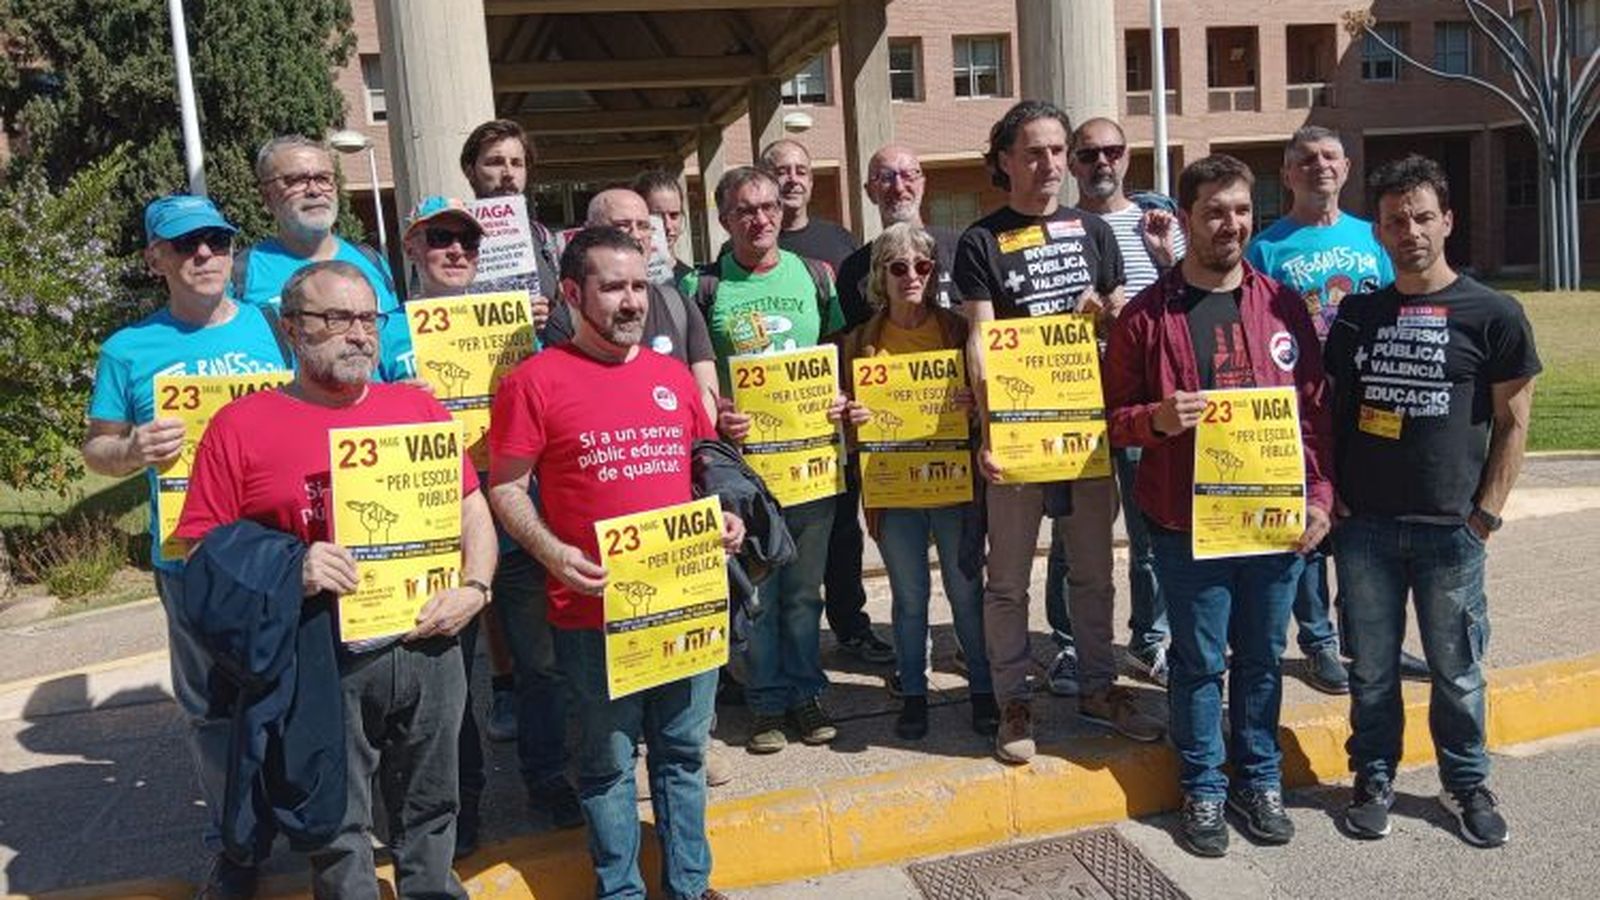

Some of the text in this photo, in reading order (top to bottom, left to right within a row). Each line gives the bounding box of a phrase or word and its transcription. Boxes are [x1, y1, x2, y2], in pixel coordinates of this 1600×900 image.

[1023, 241, 1083, 260] INVERSIÓ
[1028, 255, 1088, 276] PÚBLICA
[1032, 268, 1091, 290] VALENCIÀ
[414, 307, 450, 334] 23
[473, 301, 528, 327] VAGA
[1028, 296, 1077, 317] EDUCA
[458, 336, 481, 352] PER
[988, 328, 1019, 350] 23
[1040, 324, 1090, 346] VAGA
[1377, 327, 1449, 345] INVERSIÓ
[1026, 352, 1093, 369] PER L'ESCOLA
[1373, 341, 1446, 363] PÚBLICA
[737, 366, 765, 389] 23
[785, 357, 831, 382] VAGA
[859, 358, 958, 387] 23 VAGA
[1371, 360, 1445, 379] VALENCIÀ
[161, 385, 200, 410] 23
[772, 383, 833, 403] PER L'ESCOLA
[1365, 385, 1450, 405] EDUCACIÓ
[1203, 400, 1233, 423] 23
[1251, 398, 1292, 421] VAGA
[580, 424, 683, 448] Sí a un servei
[1237, 426, 1295, 443] PER L'ESCOLA
[338, 438, 379, 469] 23
[405, 433, 458, 463] VAGA
[578, 446, 627, 469] públic
[387, 468, 458, 491] PER L'ESCOLA
[597, 459, 680, 482] de qualitat
[418, 486, 459, 509] PÚBLICA
[605, 525, 642, 557] 23
[663, 507, 718, 542] VAGA
[648, 540, 722, 569] PER L'ESCOLA
